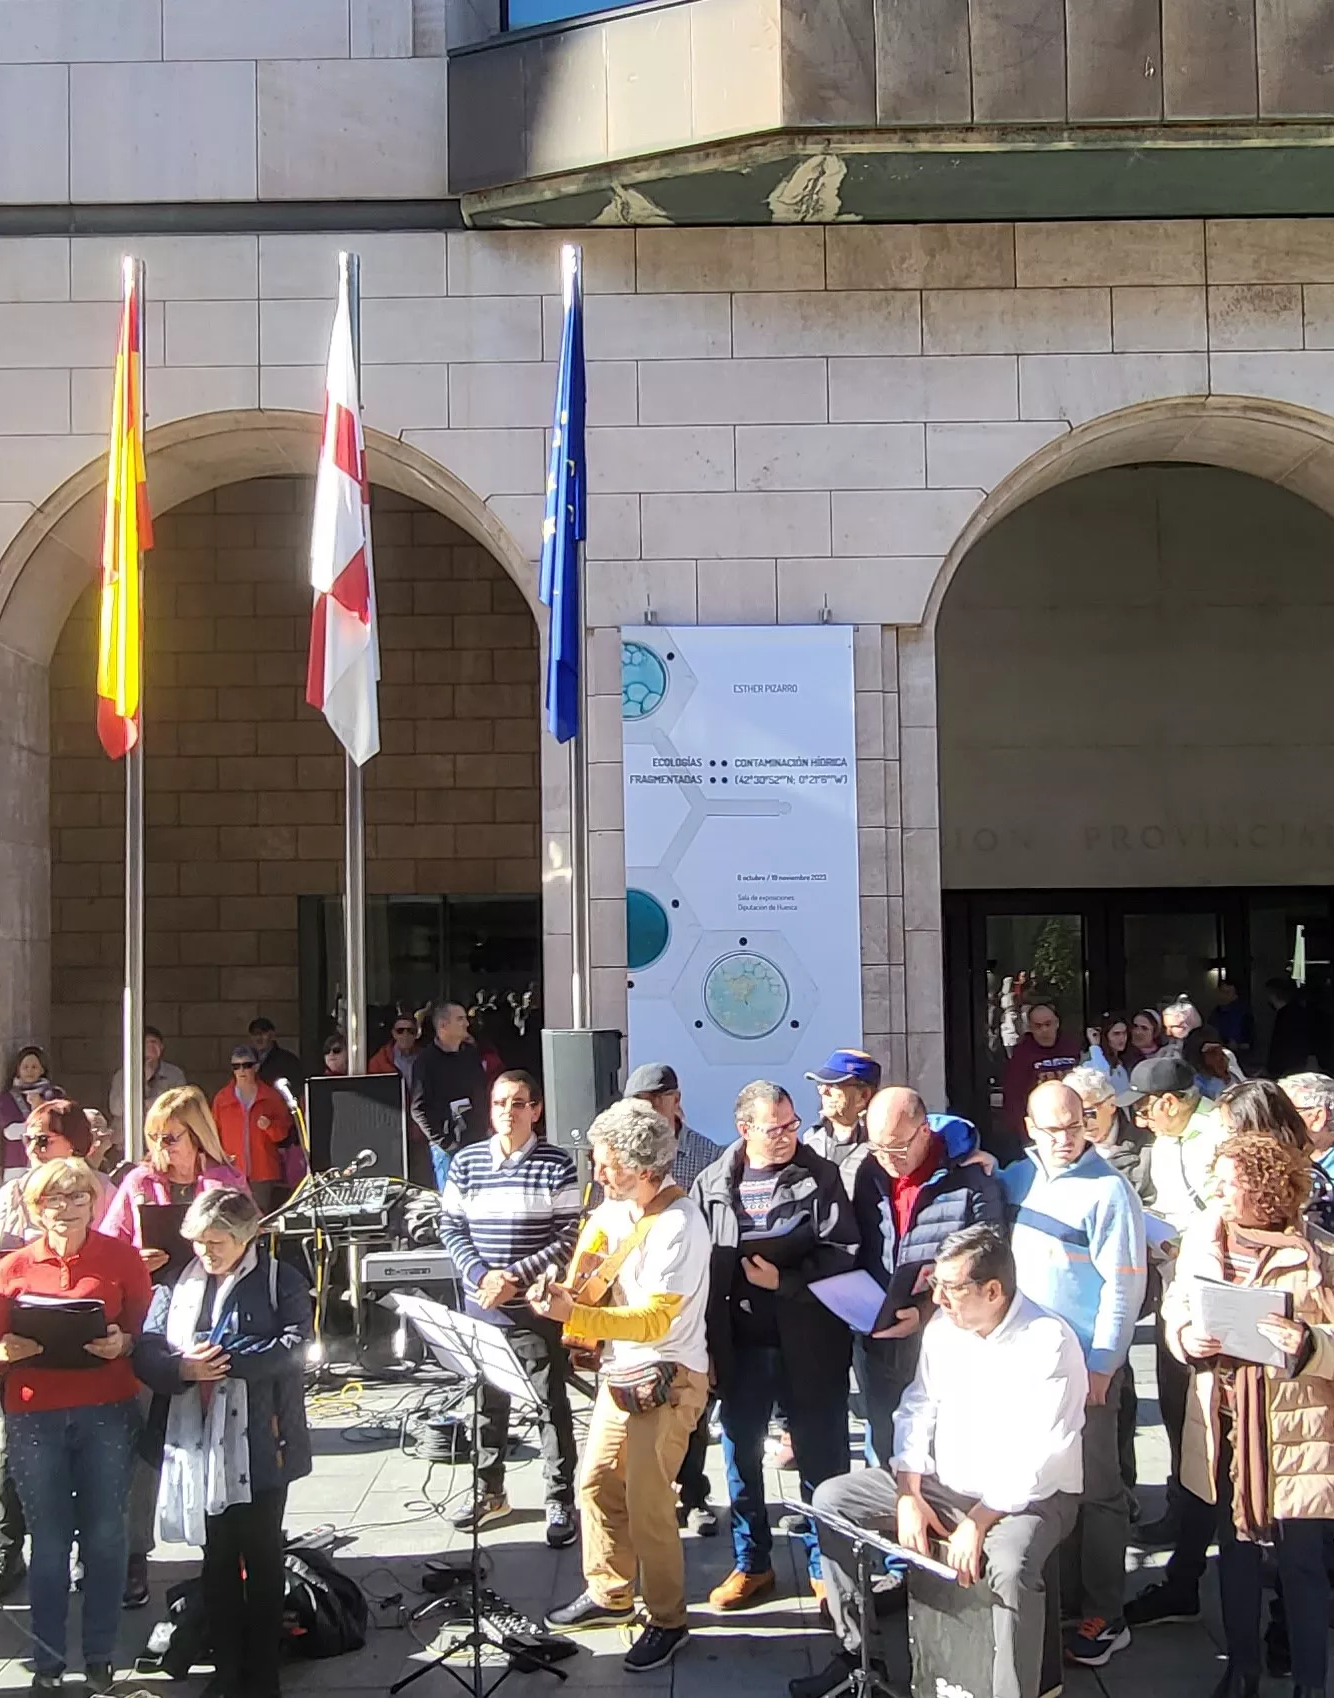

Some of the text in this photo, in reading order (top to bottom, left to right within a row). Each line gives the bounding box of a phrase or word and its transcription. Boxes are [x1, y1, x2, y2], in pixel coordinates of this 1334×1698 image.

[733, 684, 798, 693] ESTHER PIZARRO
[653, 756, 702, 767] ECOLOGÍAS
[734, 756, 808, 767] CONTAMINACIÓN
[630, 774, 703, 785] FRAGMENTADAS
